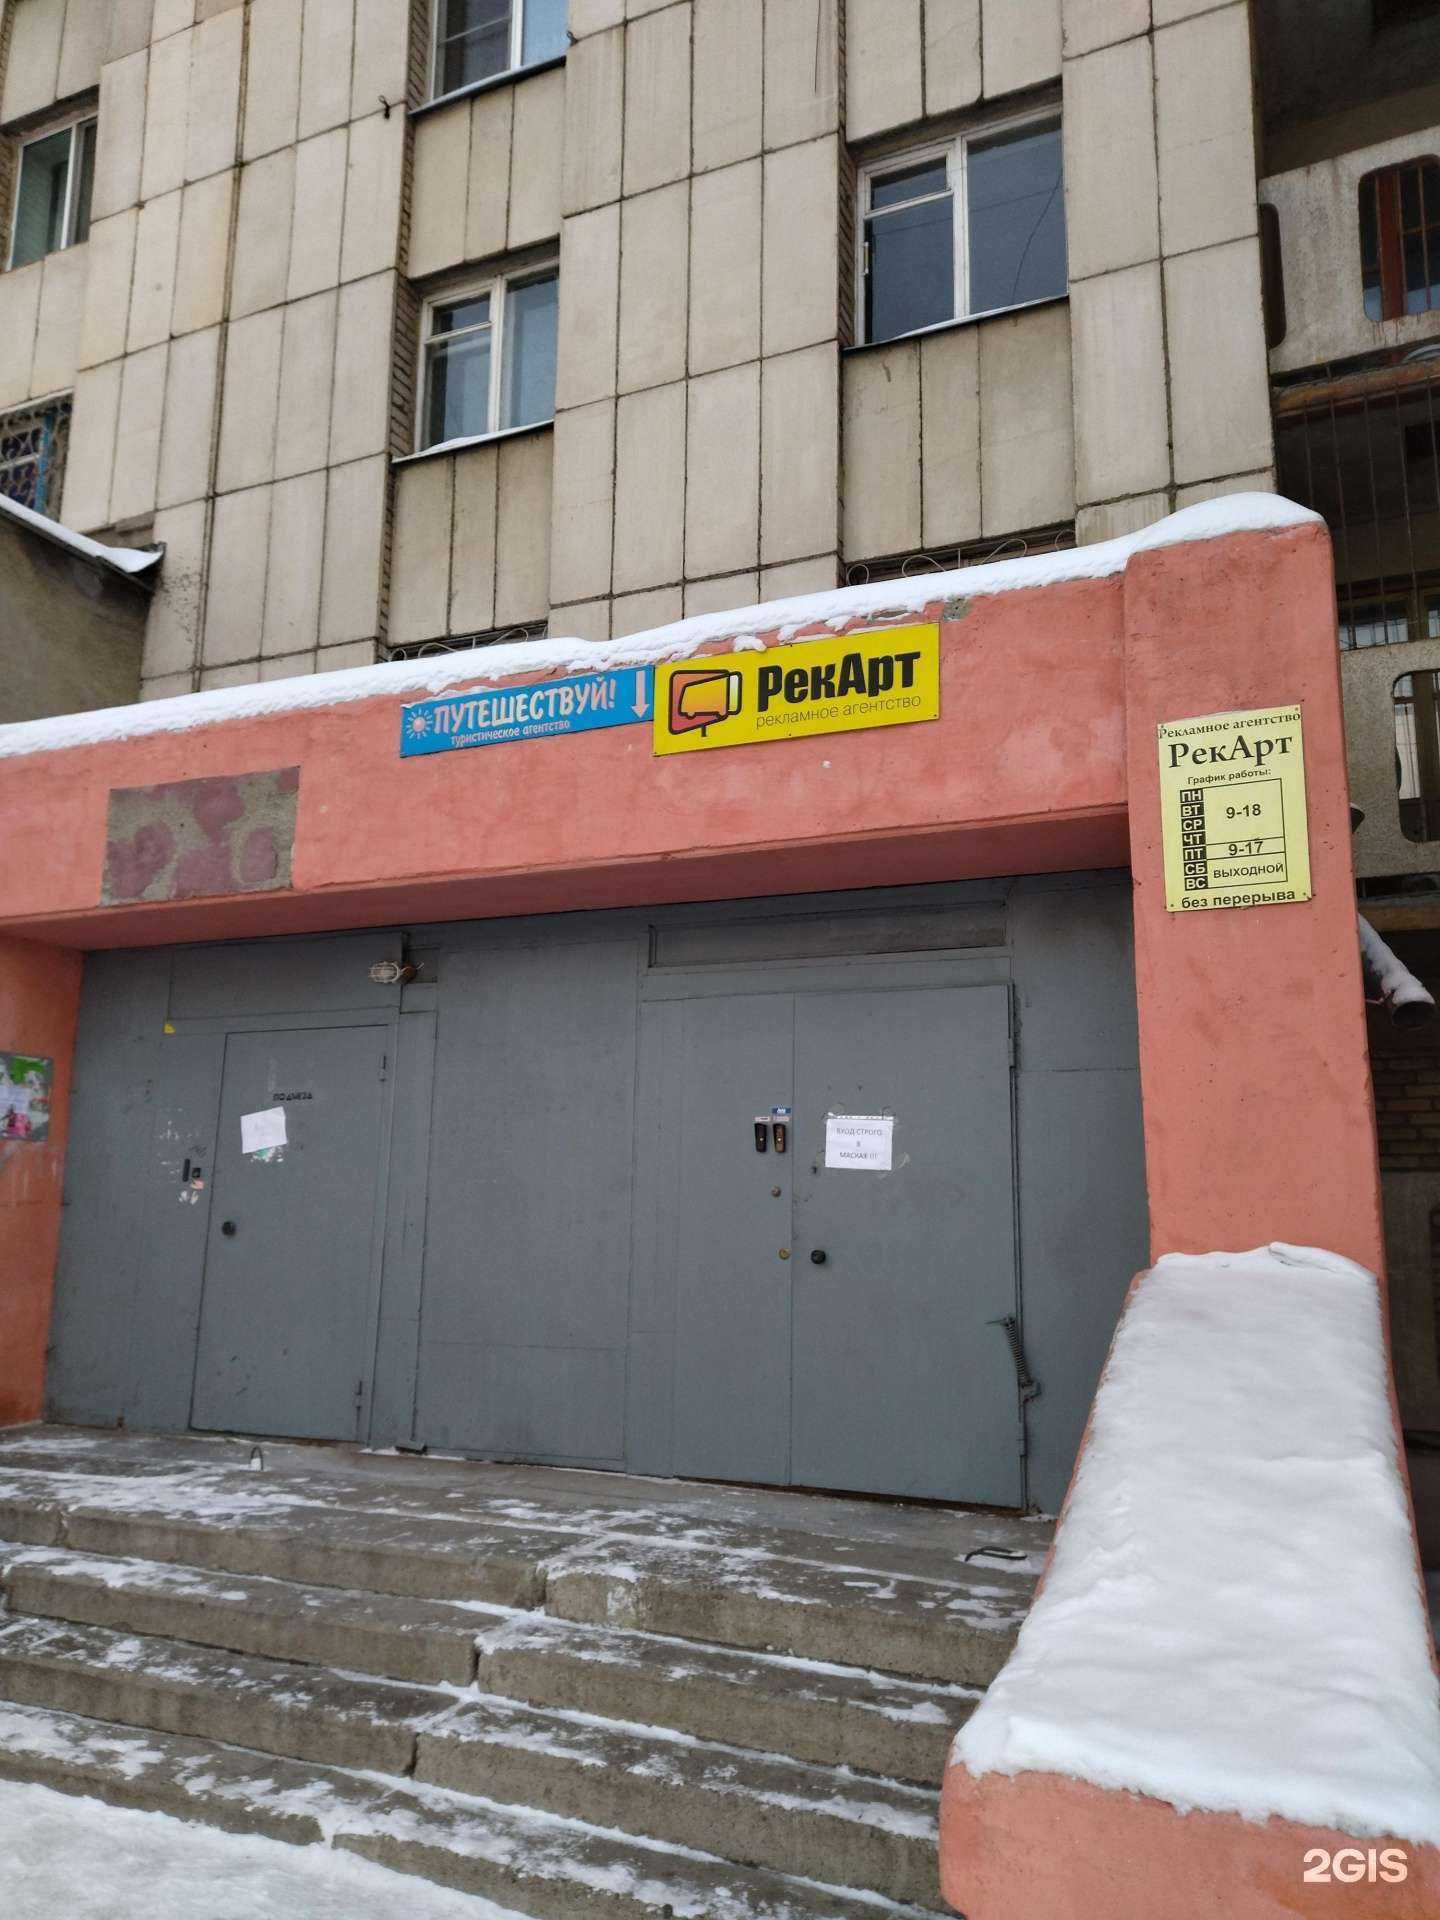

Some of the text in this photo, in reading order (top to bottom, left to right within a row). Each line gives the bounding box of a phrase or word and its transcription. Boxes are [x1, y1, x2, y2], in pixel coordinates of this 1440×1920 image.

[757, 651, 921, 713] РекАрт
[433, 676, 617, 734] ПУТЕШЕСТВУЙ!
[756, 695, 921, 729] рекламное агентство
[451, 719, 571, 747] туристическое агентство
[1159, 712, 1301, 739] Рекламное агентство
[1168, 735, 1292, 768] РекАрт
[1187, 768, 1271, 785] График работы:
[1181, 790, 1202, 803] ПН
[1182, 804, 1203, 817] ВТ
[1226, 803, 1261, 819] 9-18
[1183, 819, 1203, 832] СР
[1183, 833, 1204, 846] ЧТ
[1184, 848, 1205, 861] ПТ
[1228, 841, 1264, 856] 9-17
[1184, 863, 1206, 875] СБ
[1186, 877, 1207, 889] ВС
[1181, 890, 1296, 909] без перерыва
